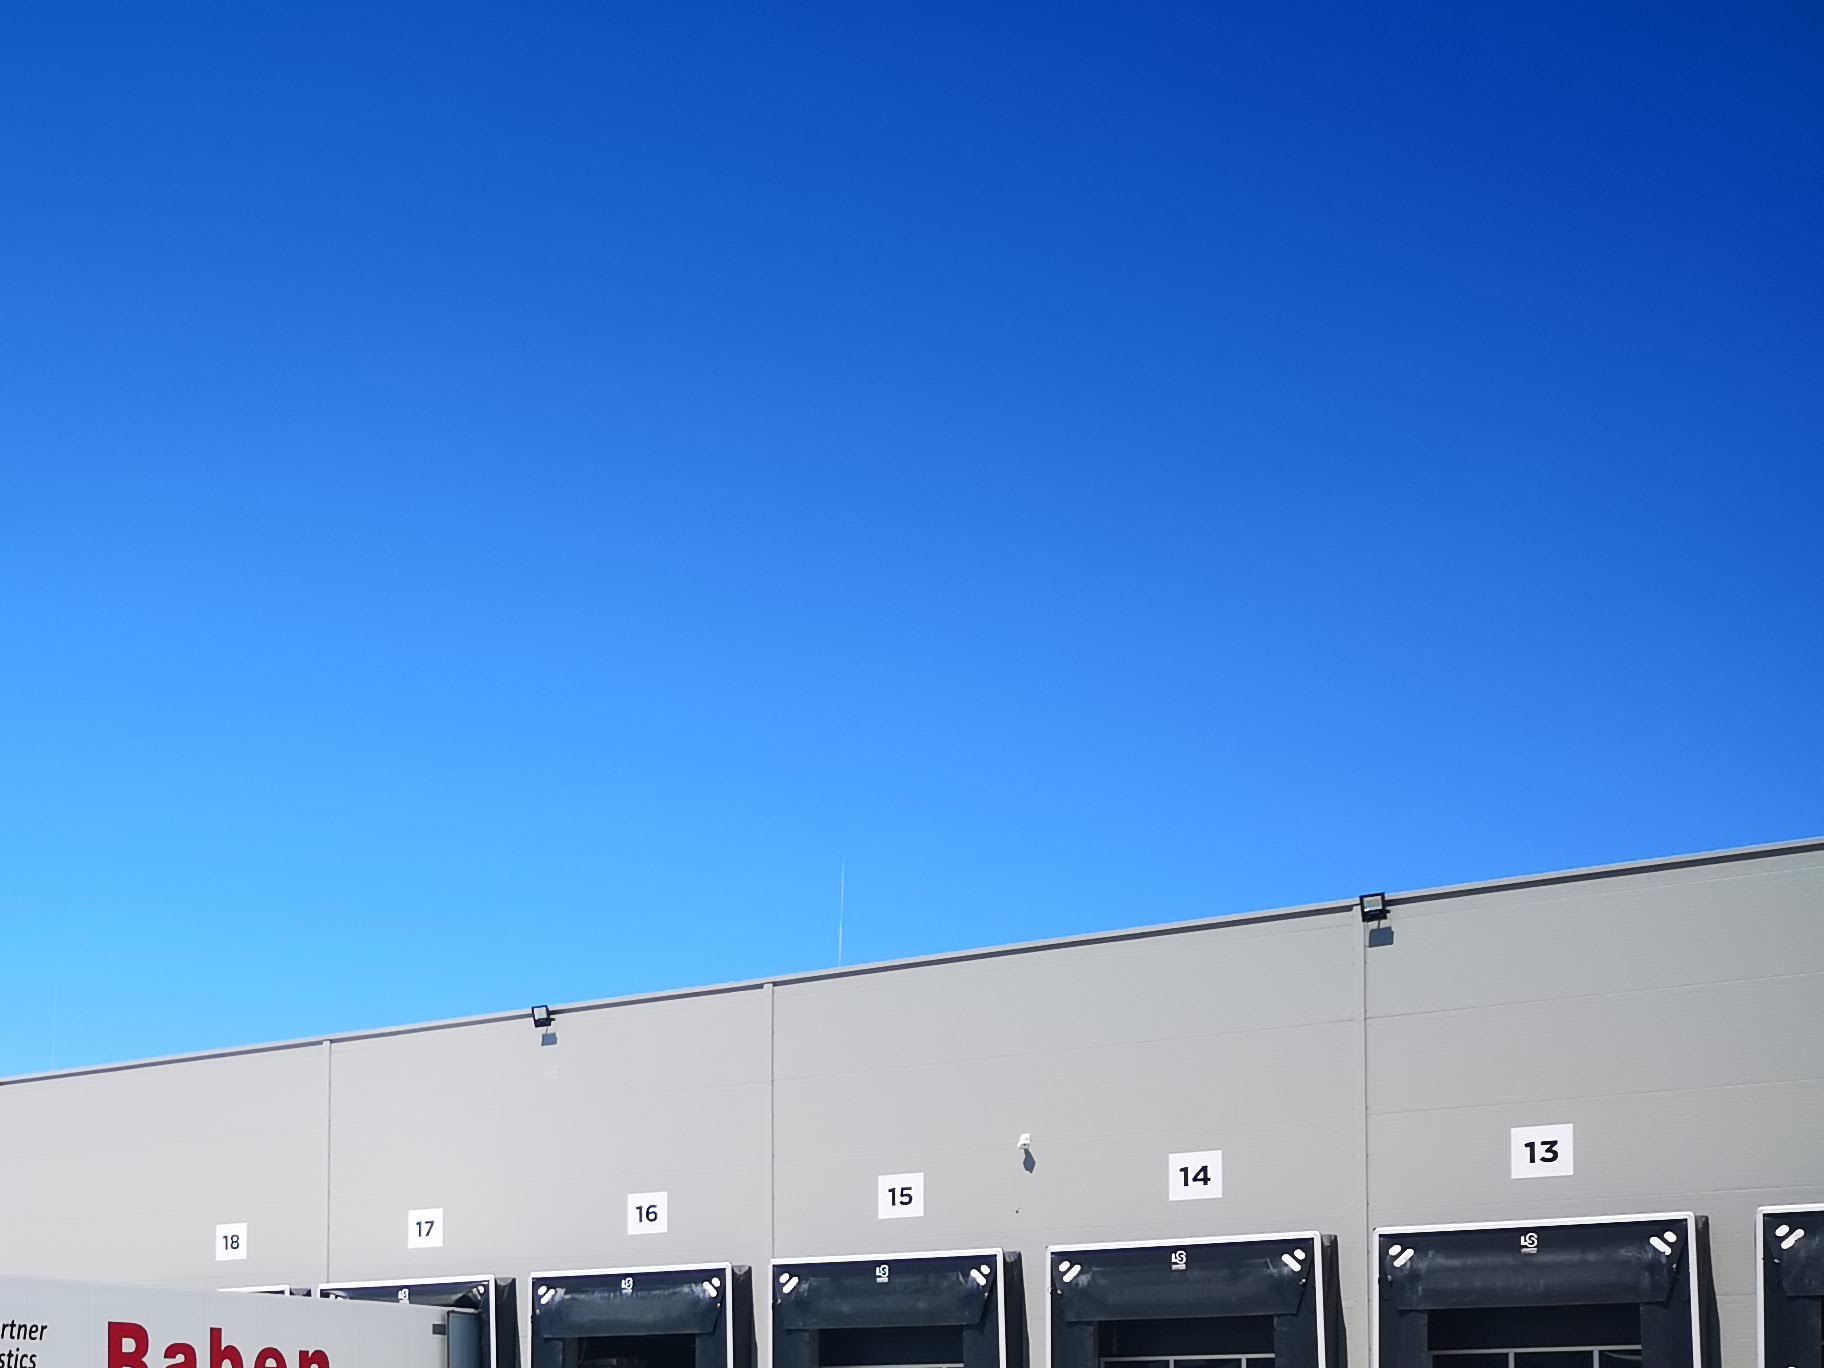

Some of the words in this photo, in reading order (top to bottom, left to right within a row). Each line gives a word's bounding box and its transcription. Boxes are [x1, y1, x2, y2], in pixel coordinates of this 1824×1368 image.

[1524, 1139, 1559, 1164] 13
[1179, 1165, 1212, 1187] 14
[887, 1186, 913, 1207] 15
[635, 1204, 658, 1223] 16
[415, 1220, 435, 1238] 17
[222, 1234, 240, 1251] 18
